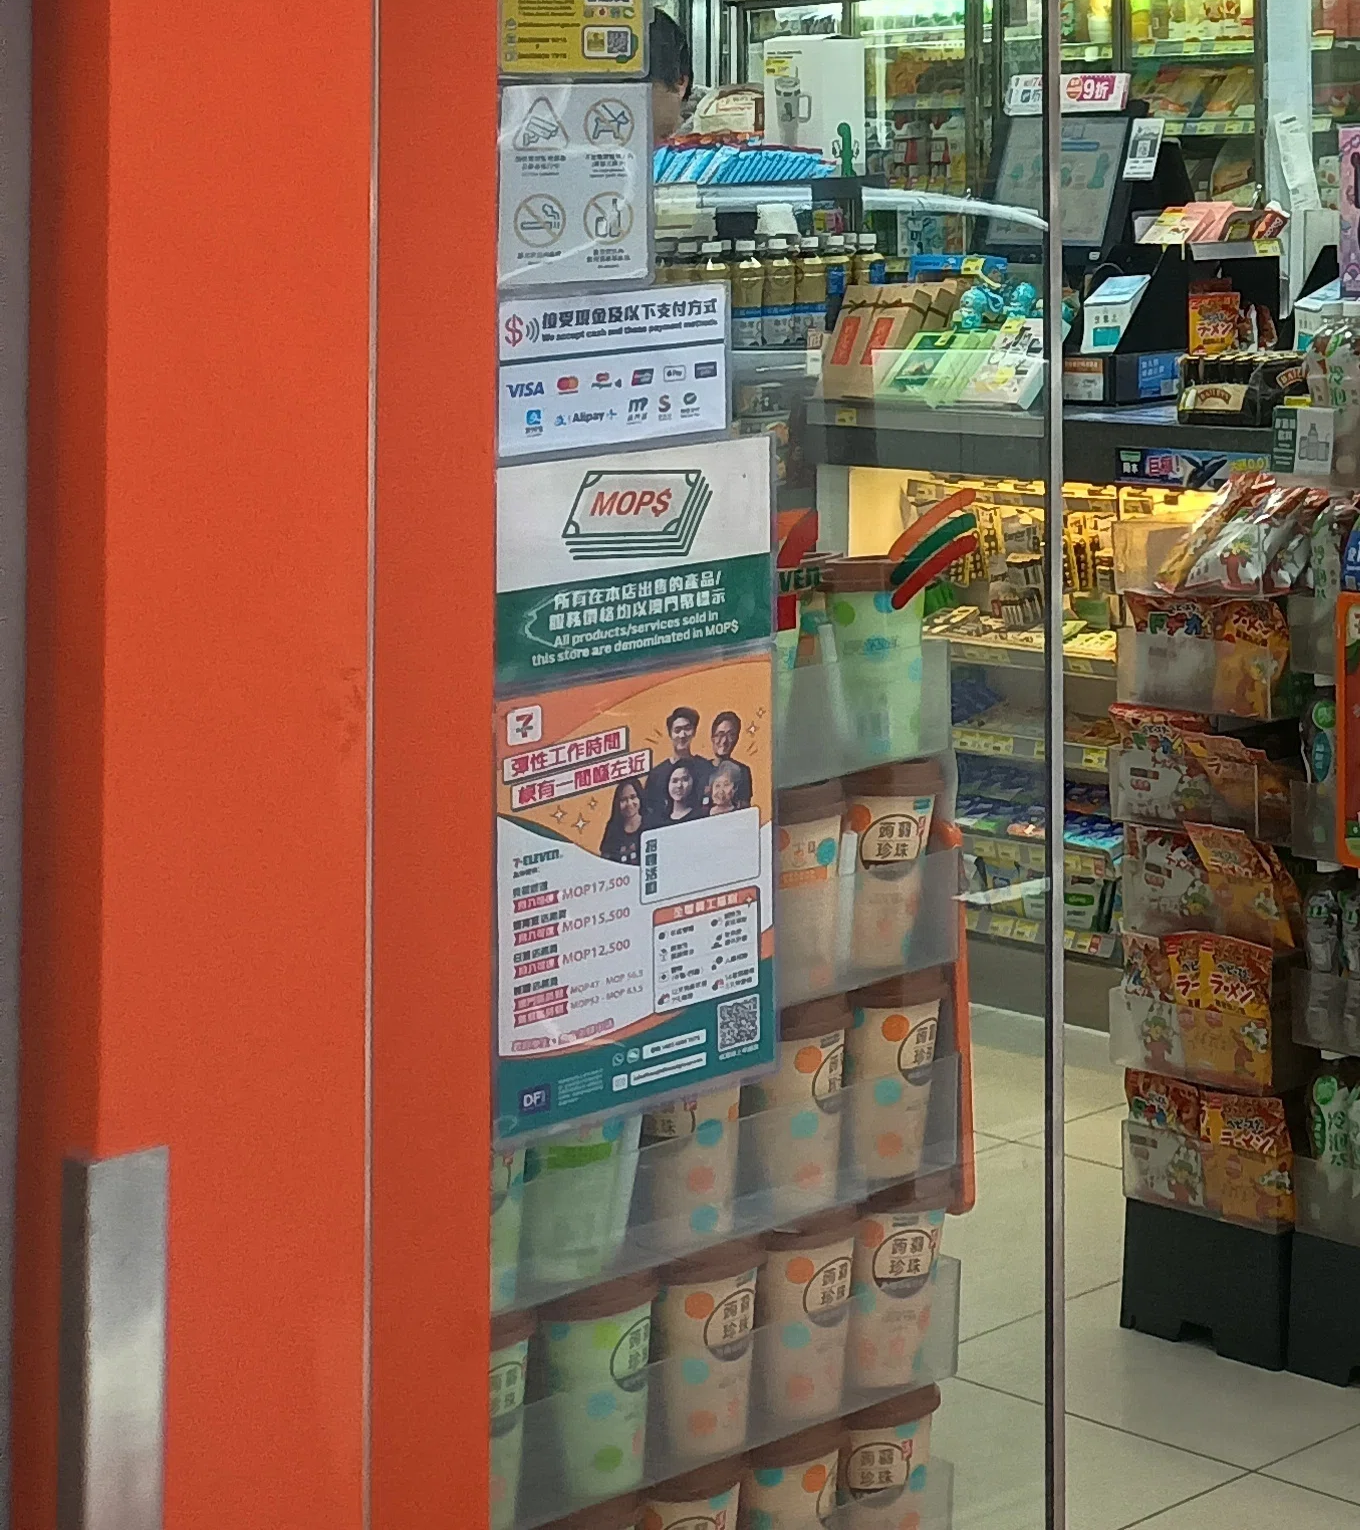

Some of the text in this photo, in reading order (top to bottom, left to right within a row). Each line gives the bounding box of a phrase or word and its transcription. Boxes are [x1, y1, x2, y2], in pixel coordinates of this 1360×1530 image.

[542, 298, 718, 330] 接受現金及以下支付方式
[506, 381, 545, 399] VISA
[572, 410, 606, 425] Alipay
[589, 487, 673, 518] MOP$
[553, 570, 722, 611] 所有在本店出售的產品/
[548, 588, 726, 632] 服務價格均以澳門幣標示
[532, 618, 740, 668] this store are denominated in MOP$
[554, 609, 719, 649] All products/services sold in
[511, 731, 621, 777] 彈性工作時間
[875, 842, 909, 860] 珍珠
[562, 874, 631, 901] MOP17,500
[562, 906, 631, 933] MOP15,500
[562, 938, 631, 966] MOP12,500
